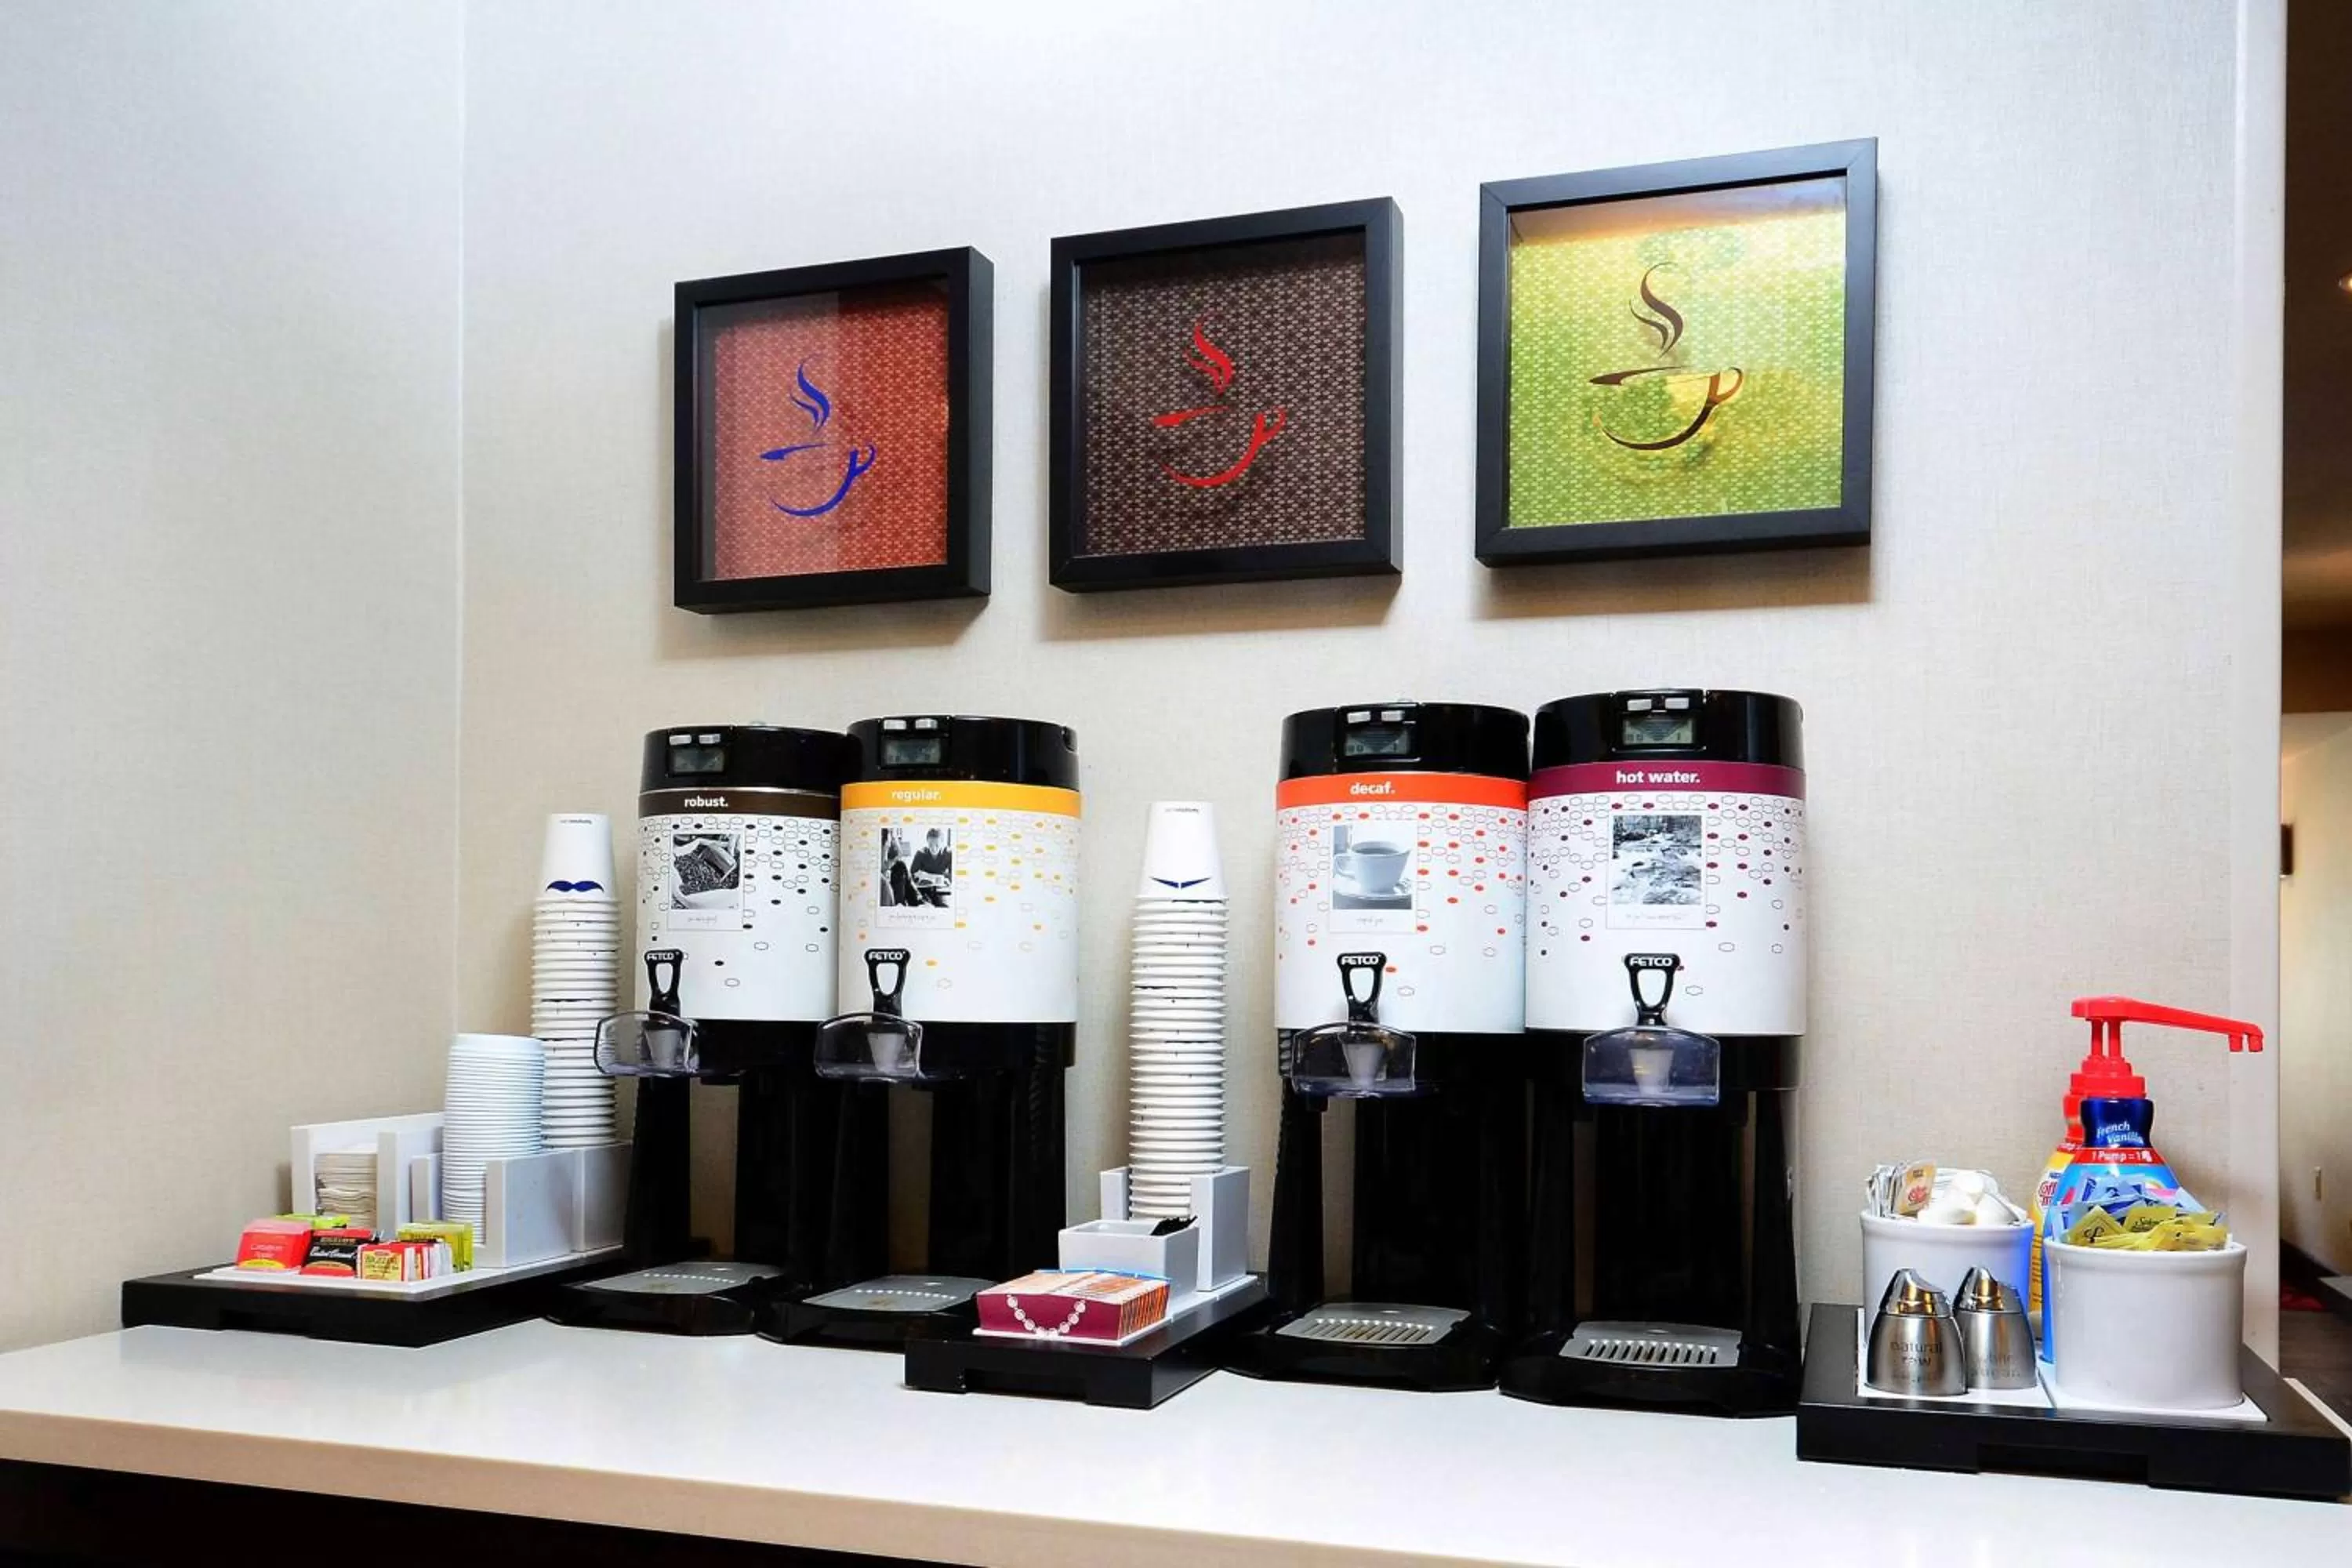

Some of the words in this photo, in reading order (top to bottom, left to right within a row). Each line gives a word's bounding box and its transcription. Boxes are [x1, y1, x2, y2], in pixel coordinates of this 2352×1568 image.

[1616, 770, 1644, 784] hot
[1649, 771, 1700, 784] water.
[1350, 781, 1396, 796] decaf.
[891, 788, 942, 802] regular.
[684, 796, 728, 808] robust.
[646, 952, 675, 961] FETCO
[868, 951, 902, 960] FETCO
[1341, 954, 1379, 965] FETCO
[1629, 955, 1672, 967] FETCO
[1889, 1341, 1943, 1354] natural
